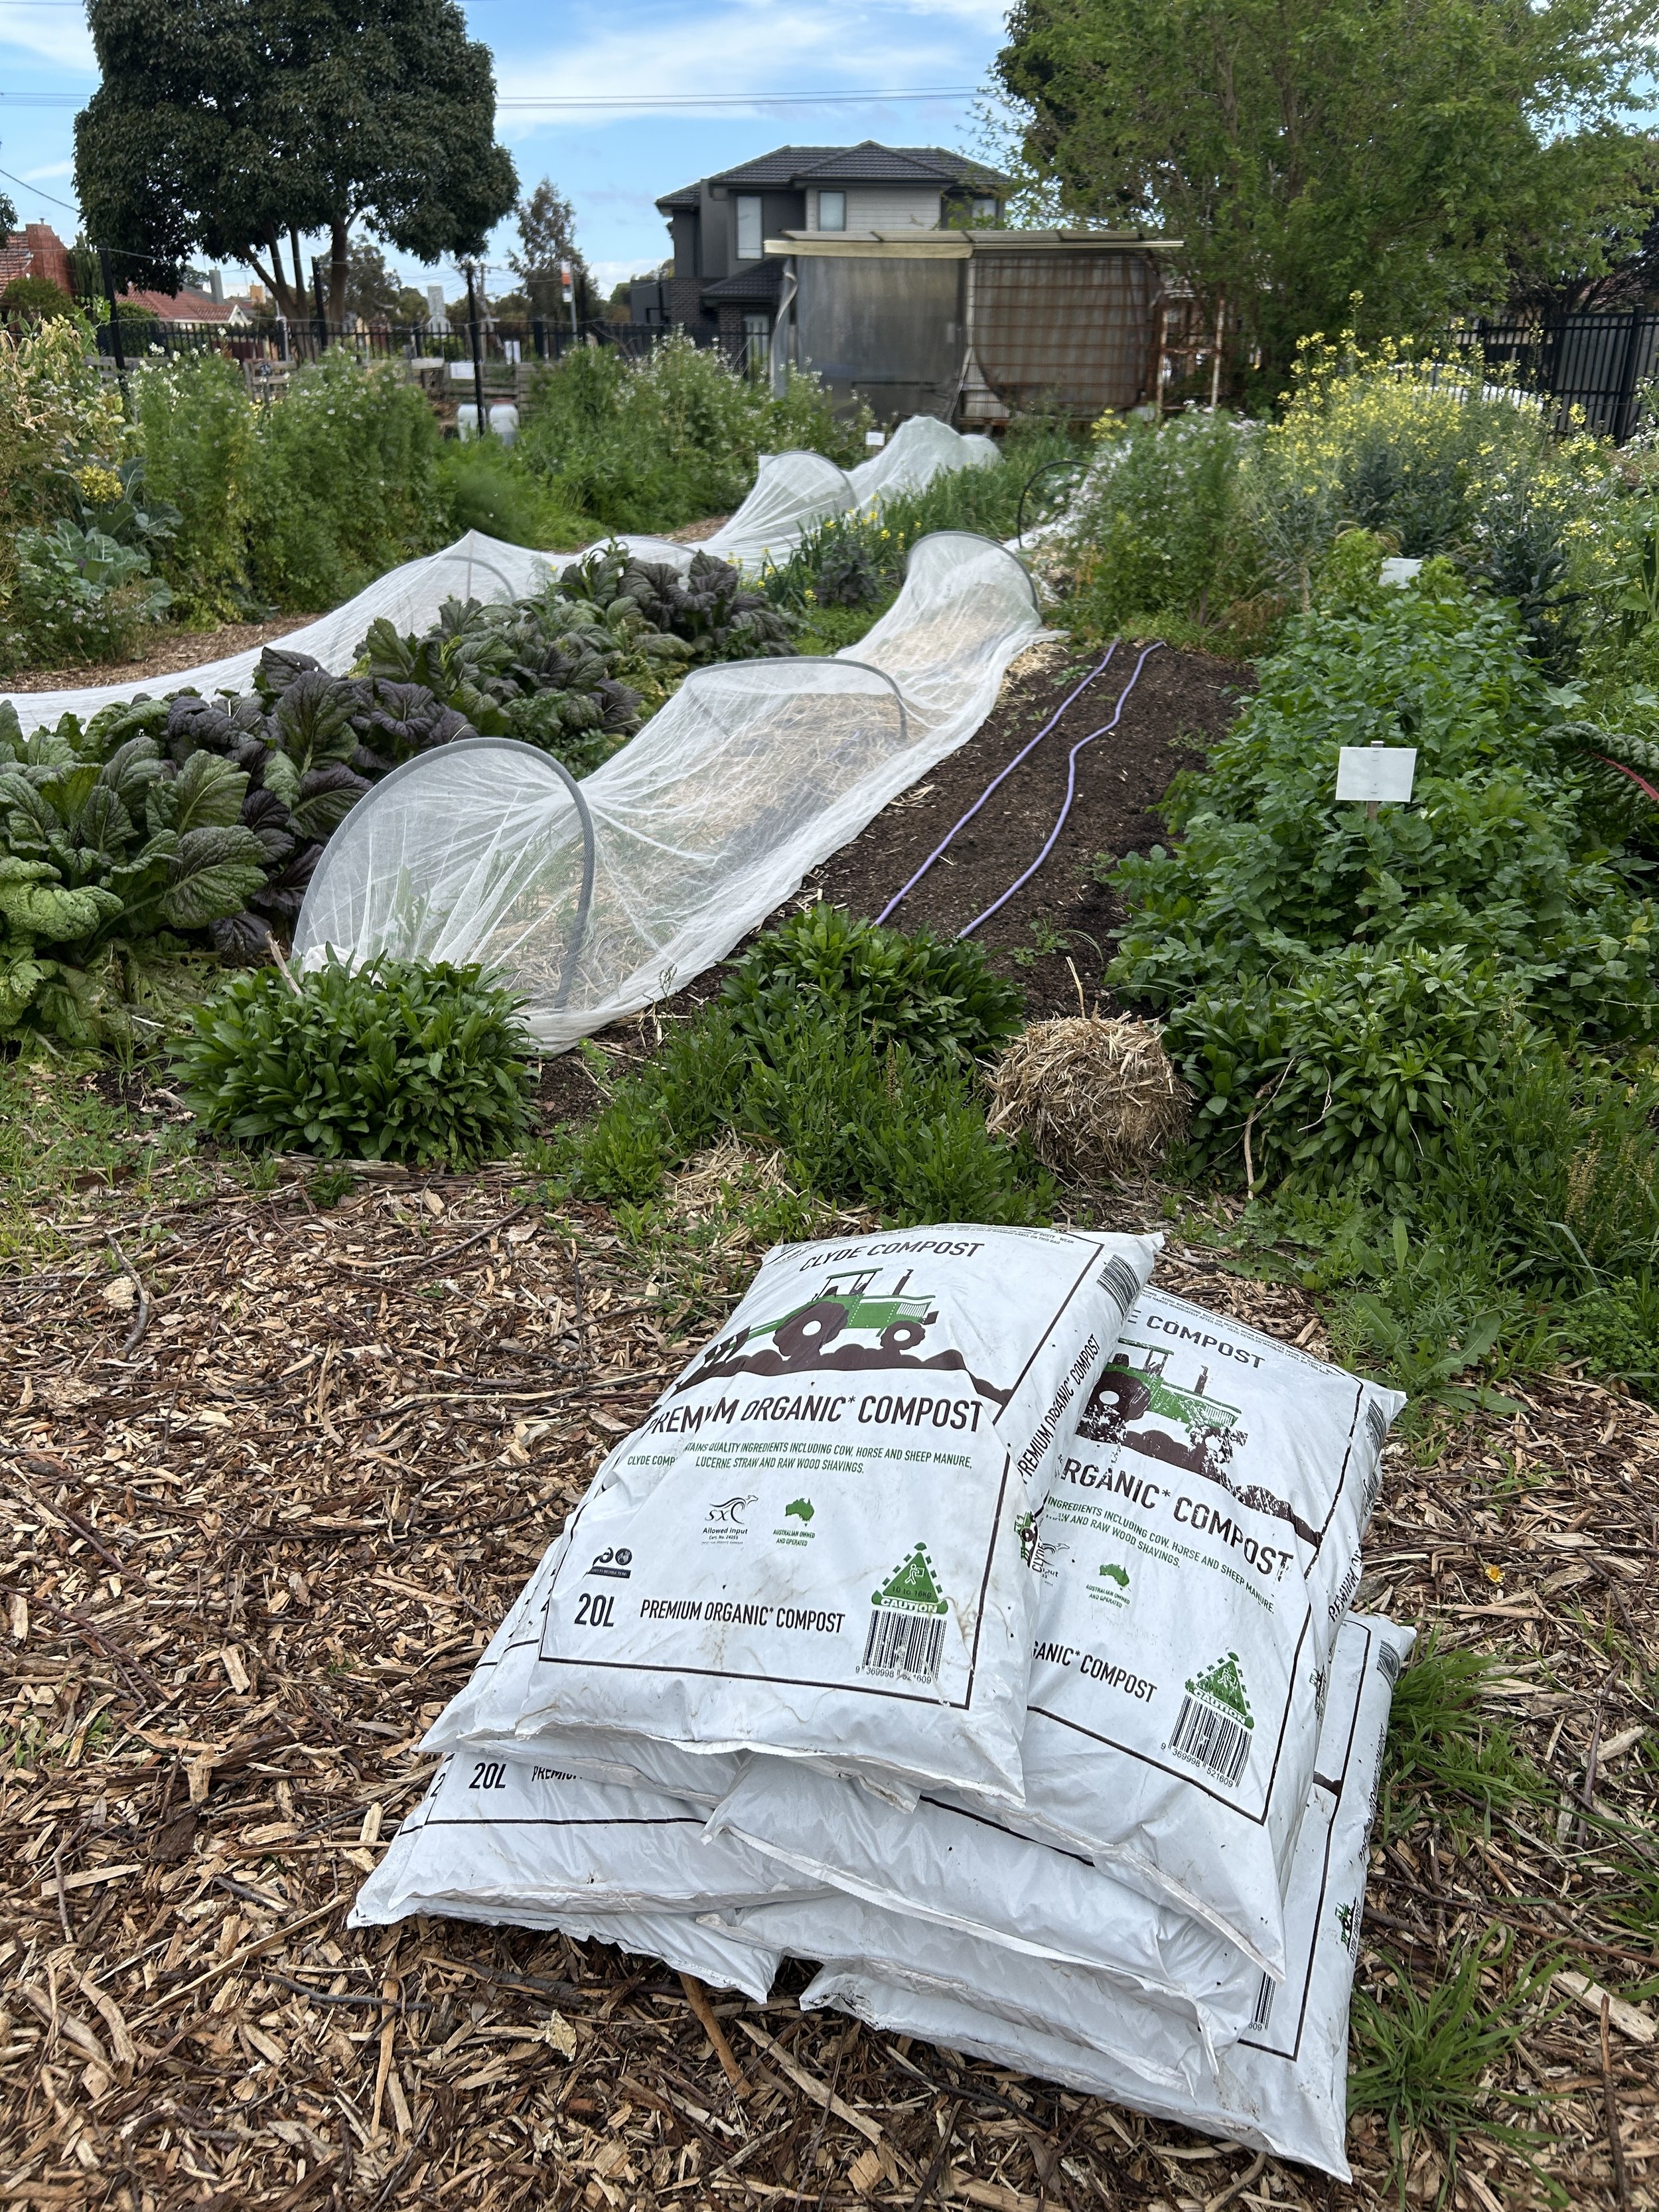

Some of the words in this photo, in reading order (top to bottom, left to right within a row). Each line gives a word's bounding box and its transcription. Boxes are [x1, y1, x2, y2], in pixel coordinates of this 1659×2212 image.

[799, 1245, 868, 1272] CLYDE
[867, 1240, 985, 1258] COMPOST
[1070, 1333, 1100, 1386] COMPOST
[1146, 1315, 1265, 1370] COMPOST
[640, 1396, 740, 1438] PREMM
[858, 1395, 983, 1433] COMPOST
[627, 1455, 652, 1466] CLYDE
[652, 1455, 678, 1467] COMP
[684, 1442, 709, 1453] TAINS
[708, 1442, 741, 1453] QUALITY
[741, 1442, 788, 1453] INGREDIENTS
[790, 1442, 832, 1454] INCLUDING
[856, 1447, 883, 1459] HORSE
[884, 1448, 902, 1460] AND
[904, 1449, 932, 1463] SHEEP
[933, 1452, 973, 1469] MANURE,
[733, 1457, 758, 1468] STRAW
[758, 1457, 775, 1468] AND
[776, 1457, 796, 1469] RAW
[796, 1459, 821, 1469] WOOD
[822, 1459, 865, 1474] SHAVINGS.
[772, 1528, 799, 1537] AUSTRALIAN
[1060, 1457, 1171, 1509] RGANIC
[1173, 1496, 1294, 1583] COMPOST
[786, 1538, 808, 1546] OPERATED
[1046, 1496, 1103, 1517] INGREDIENTS
[1104, 1510, 1148, 1538] INCLUDING
[1171, 1541, 1201, 1562] HORSE
[1201, 1555, 1220, 1570] AND
[1220, 1564, 1246, 1585] SHEEP
[1069, 1514, 1089, 1526] AND
[1090, 1519, 1111, 1534] RAW
[1112, 1526, 1137, 1546] WOOD
[1137, 1540, 1181, 1568] SHAVINGS.
[574, 1593, 614, 1627] 20L
[881, 1597, 938, 1613] CAUTION
[1086, 1584, 1114, 1597] AUSTRALIAN
[1114, 1591, 1131, 1605] OWNED
[640, 1599, 703, 1621] PREMIUM
[776, 1607, 845, 1633] COMPOST
[855, 1665, 861, 1674] 9
[866, 1666, 895, 1678] 369998
[1033, 1640, 1081, 1666] ANIC
[1080, 1653, 1158, 1703] COMPOST
[1194, 1688, 1247, 1726] CAUTION
[469, 1762, 507, 1789] 20L
[532, 1765, 583, 1782] PREMI
[1172, 1748, 1201, 1767] 369998
[1206, 1767, 1234, 1788] 521609
[1248, 2021, 1262, 2031] 609
